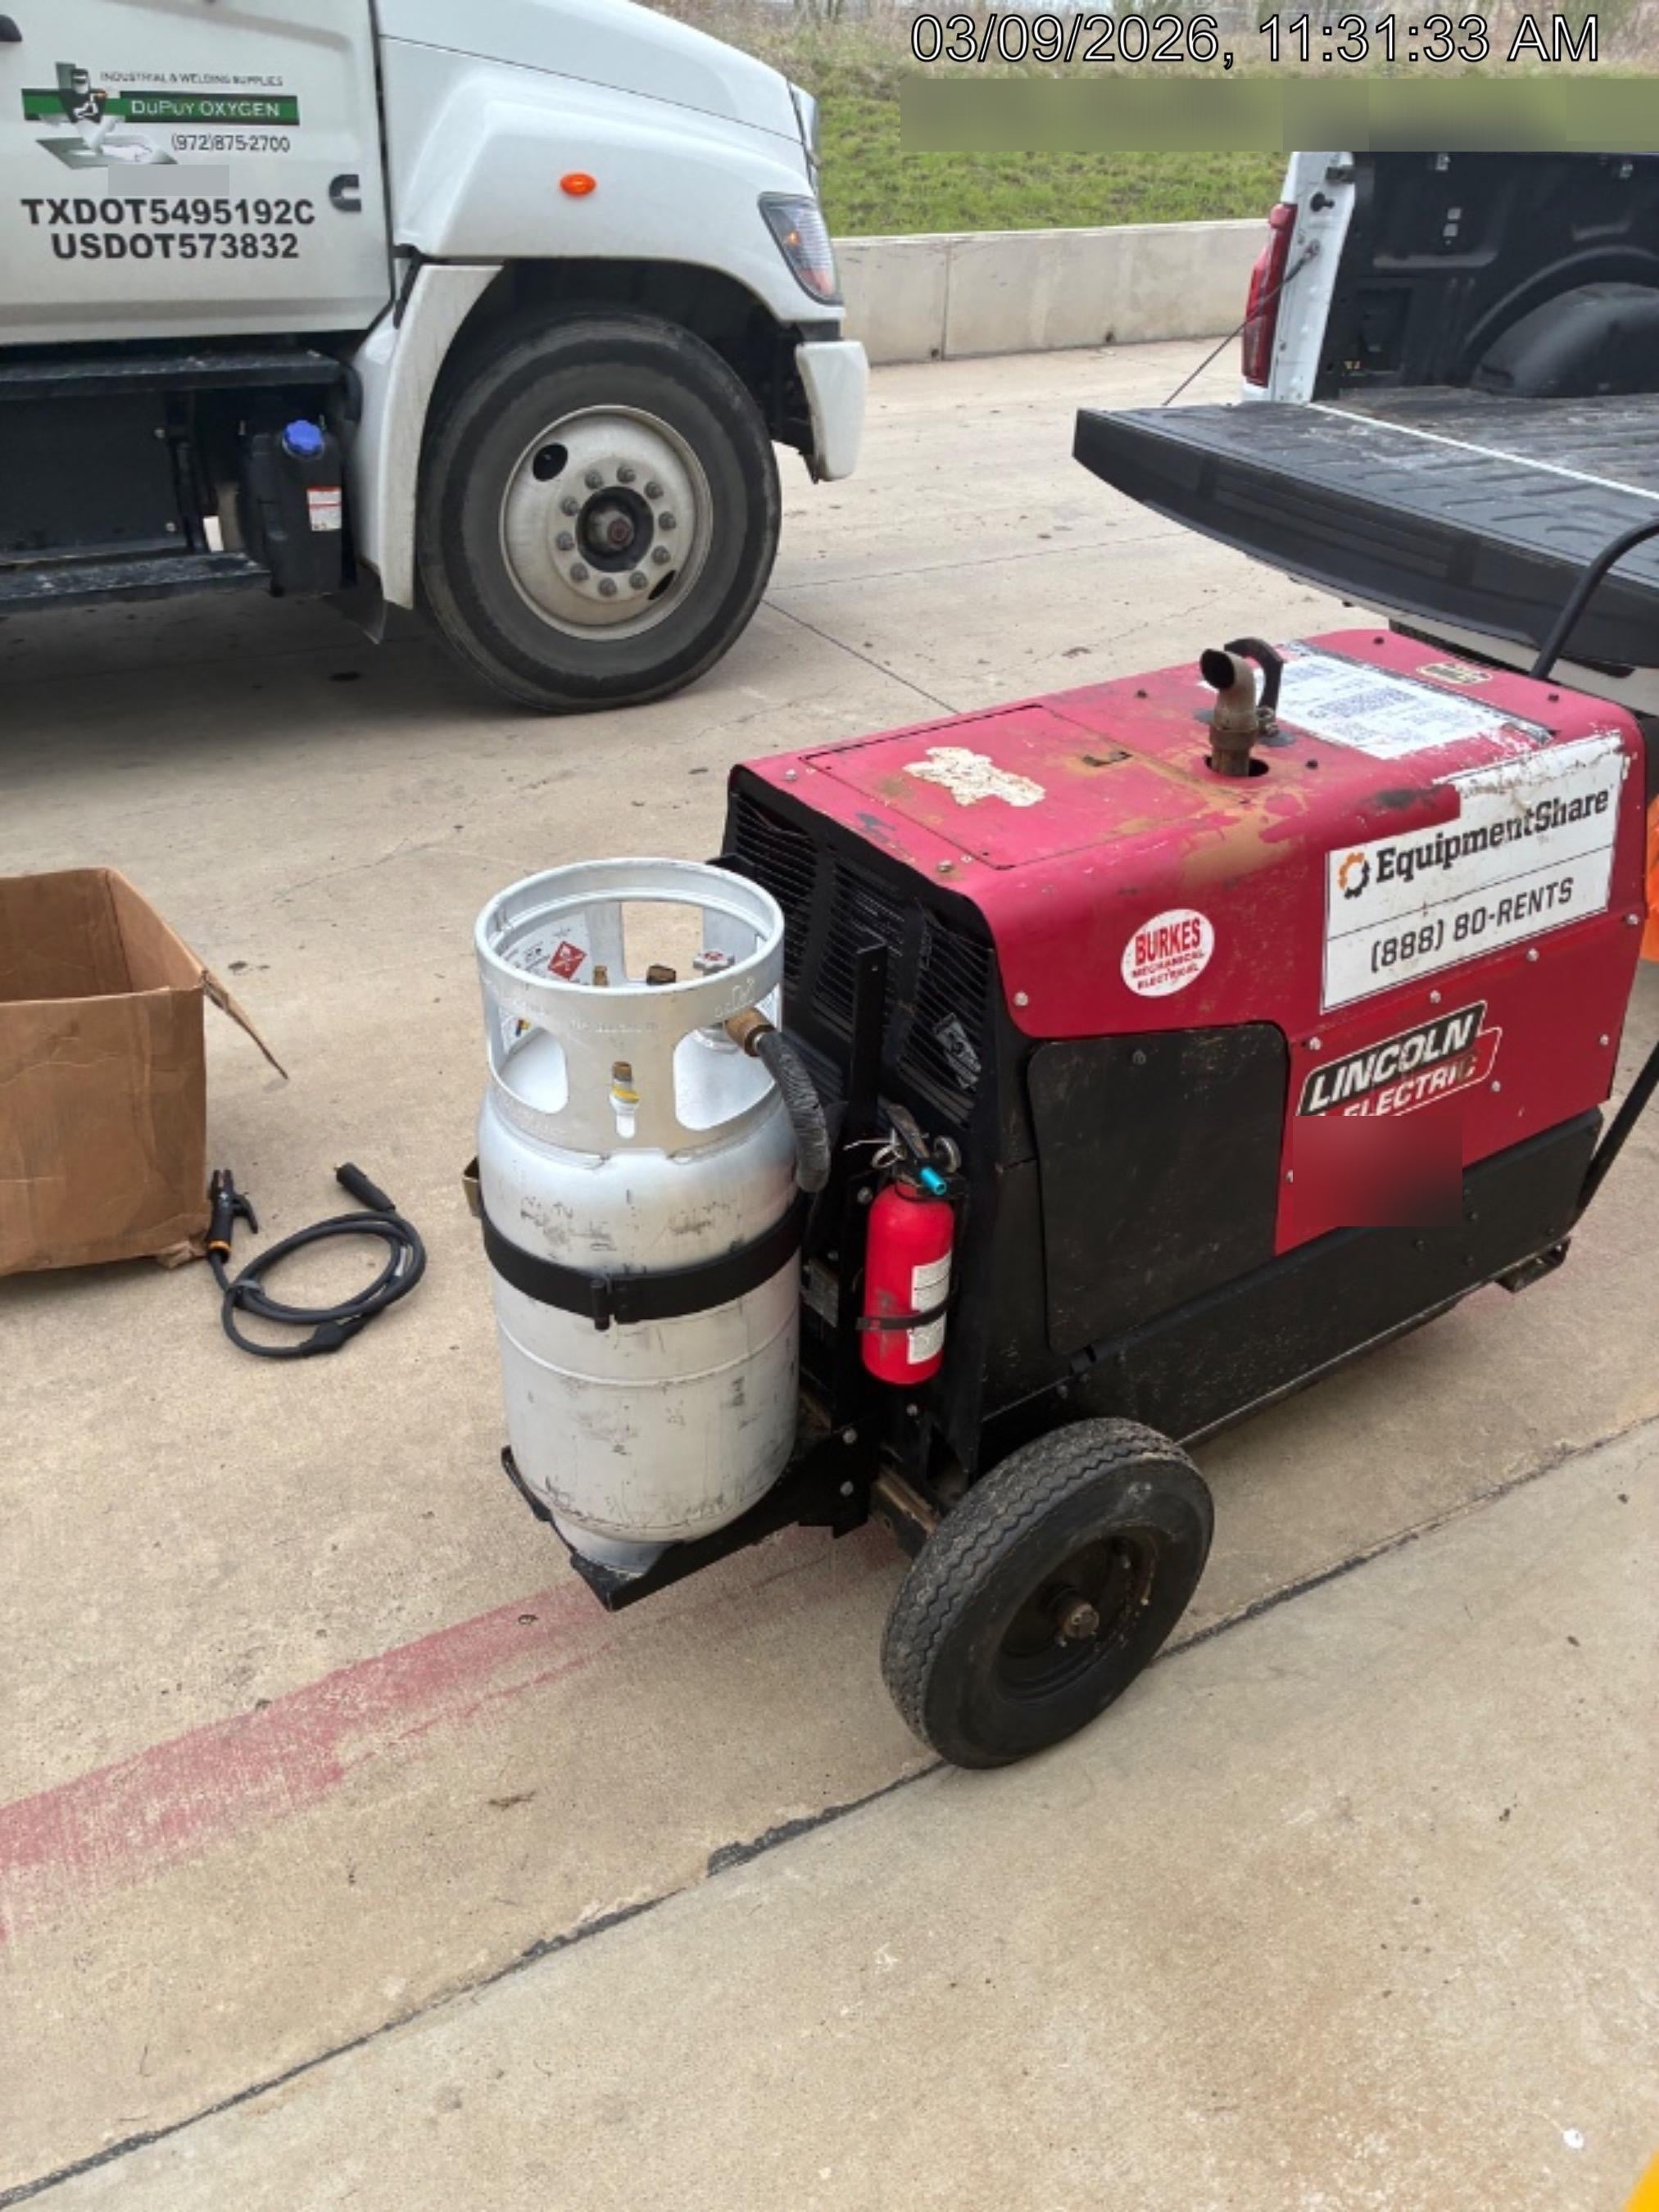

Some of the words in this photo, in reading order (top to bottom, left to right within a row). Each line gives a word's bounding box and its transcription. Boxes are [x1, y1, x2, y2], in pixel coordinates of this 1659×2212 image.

[200, 101, 280, 117] OXYGEN
[170, 134, 290, 152] (972)875-2700
[20, 197, 316, 226] TXDOT5495192C
[51, 233, 300, 260] USDOT573832
[1376, 788, 1609, 883] EquipmentShare
[1135, 916, 1201, 967] BURKES
[1371, 918, 1444, 973] (888)
[1453, 877, 1575, 942] 80-RENTS
[1308, 1014, 1474, 1112] LINCOLN
